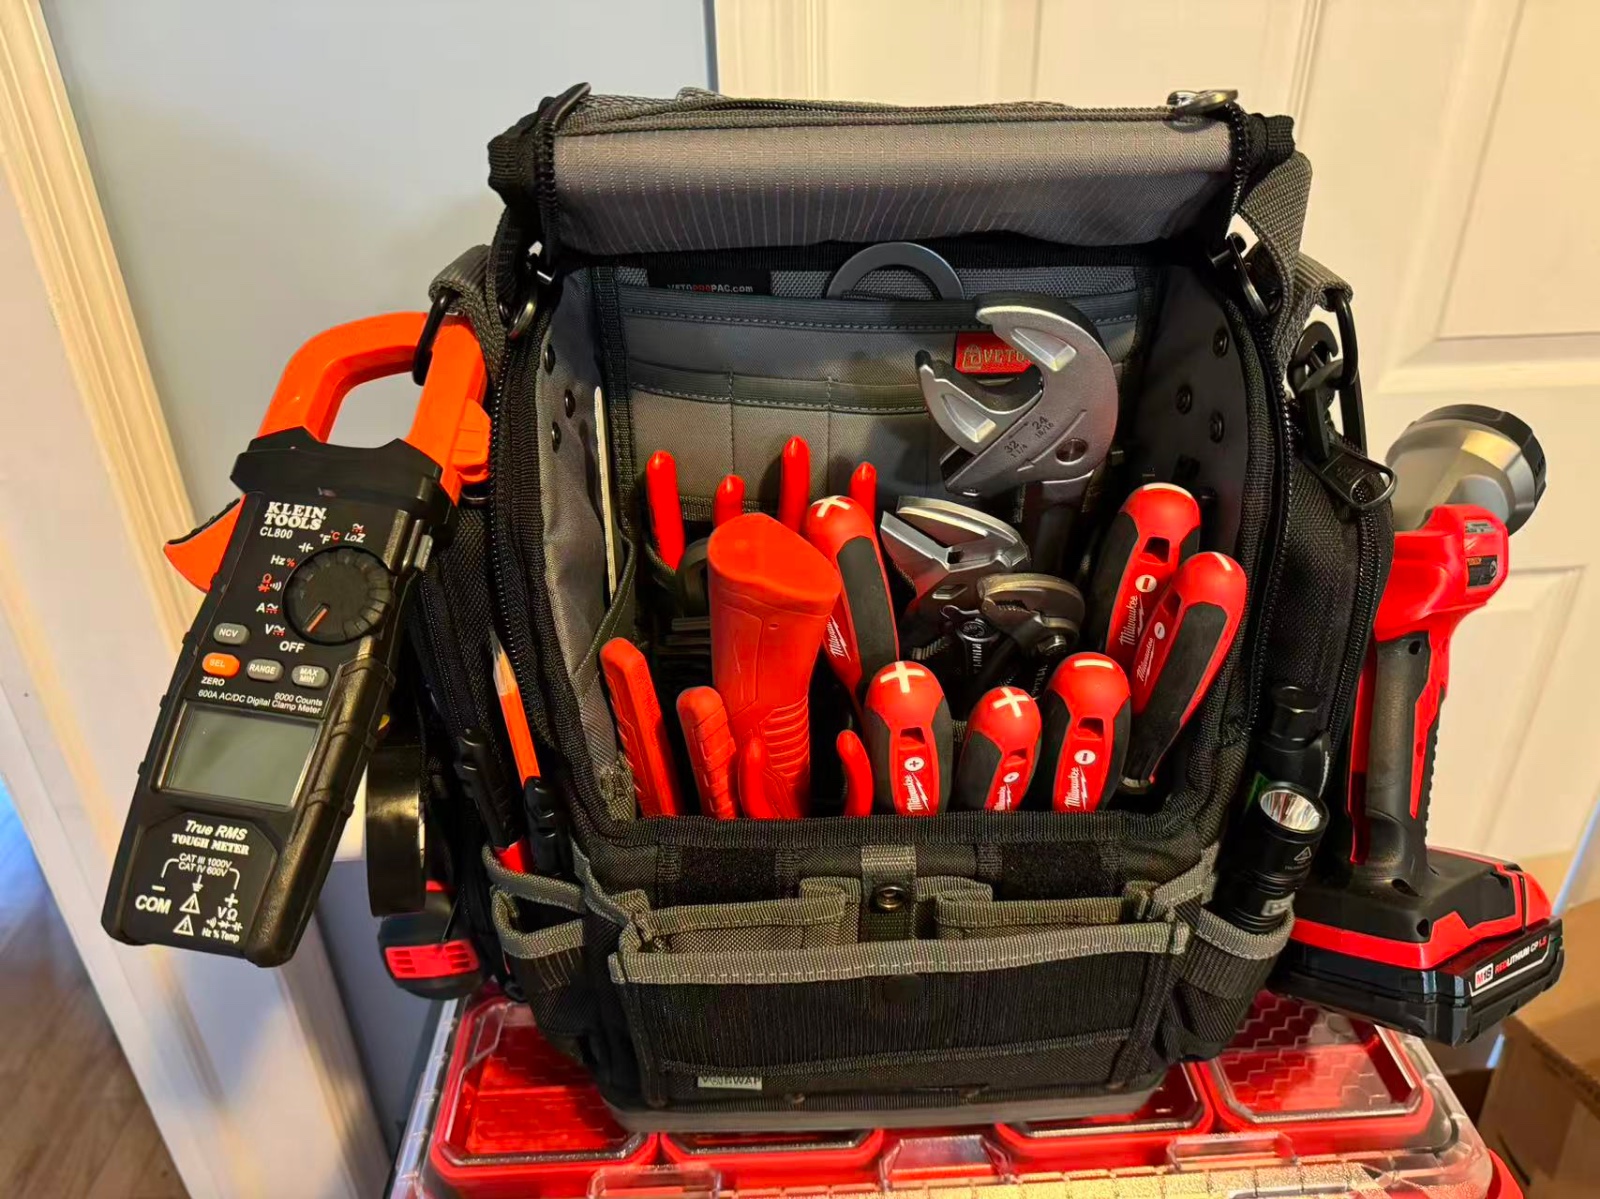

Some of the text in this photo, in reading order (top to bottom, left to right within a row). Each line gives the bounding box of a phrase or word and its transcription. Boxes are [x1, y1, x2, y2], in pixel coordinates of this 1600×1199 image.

[1032, 416, 1048, 430] 24
[1004, 441, 1019, 453] 32
[267, 501, 327, 519] KLEIN
[264, 512, 322, 530] TOOLS
[260, 526, 293, 540] CL800
[344, 532, 366, 543] LoZ
[270, 554, 286, 566] Hz
[1119, 595, 1138, 646] Milwaukee
[219, 628, 239, 638] NCV
[279, 640, 305, 653] OFF
[209, 658, 226, 668] SEL
[249, 663, 276, 675] RANGE
[299, 675, 315, 683] MIN
[300, 667, 319, 677] MAX
[201, 676, 225, 687] ZERO
[198, 688, 321, 714] 600A AC/DC Digital Clamp Meter
[274, 692, 323, 707] 6000 Counts
[903, 774, 924, 813] Milwaukee
[1064, 766, 1081, 808] Milwaukee
[185, 819, 248, 841] True RMS
[171, 833, 250, 856] TOUGH METER
[179, 852, 198, 864] CAT
[207, 857, 233, 869] 1000V
[178, 861, 228, 878] CAT IV 600V
[135, 894, 172, 915] COM
[201, 927, 213, 938] Hz
[220, 930, 240, 944] Temp
[1476, 966, 1493, 987] M18
